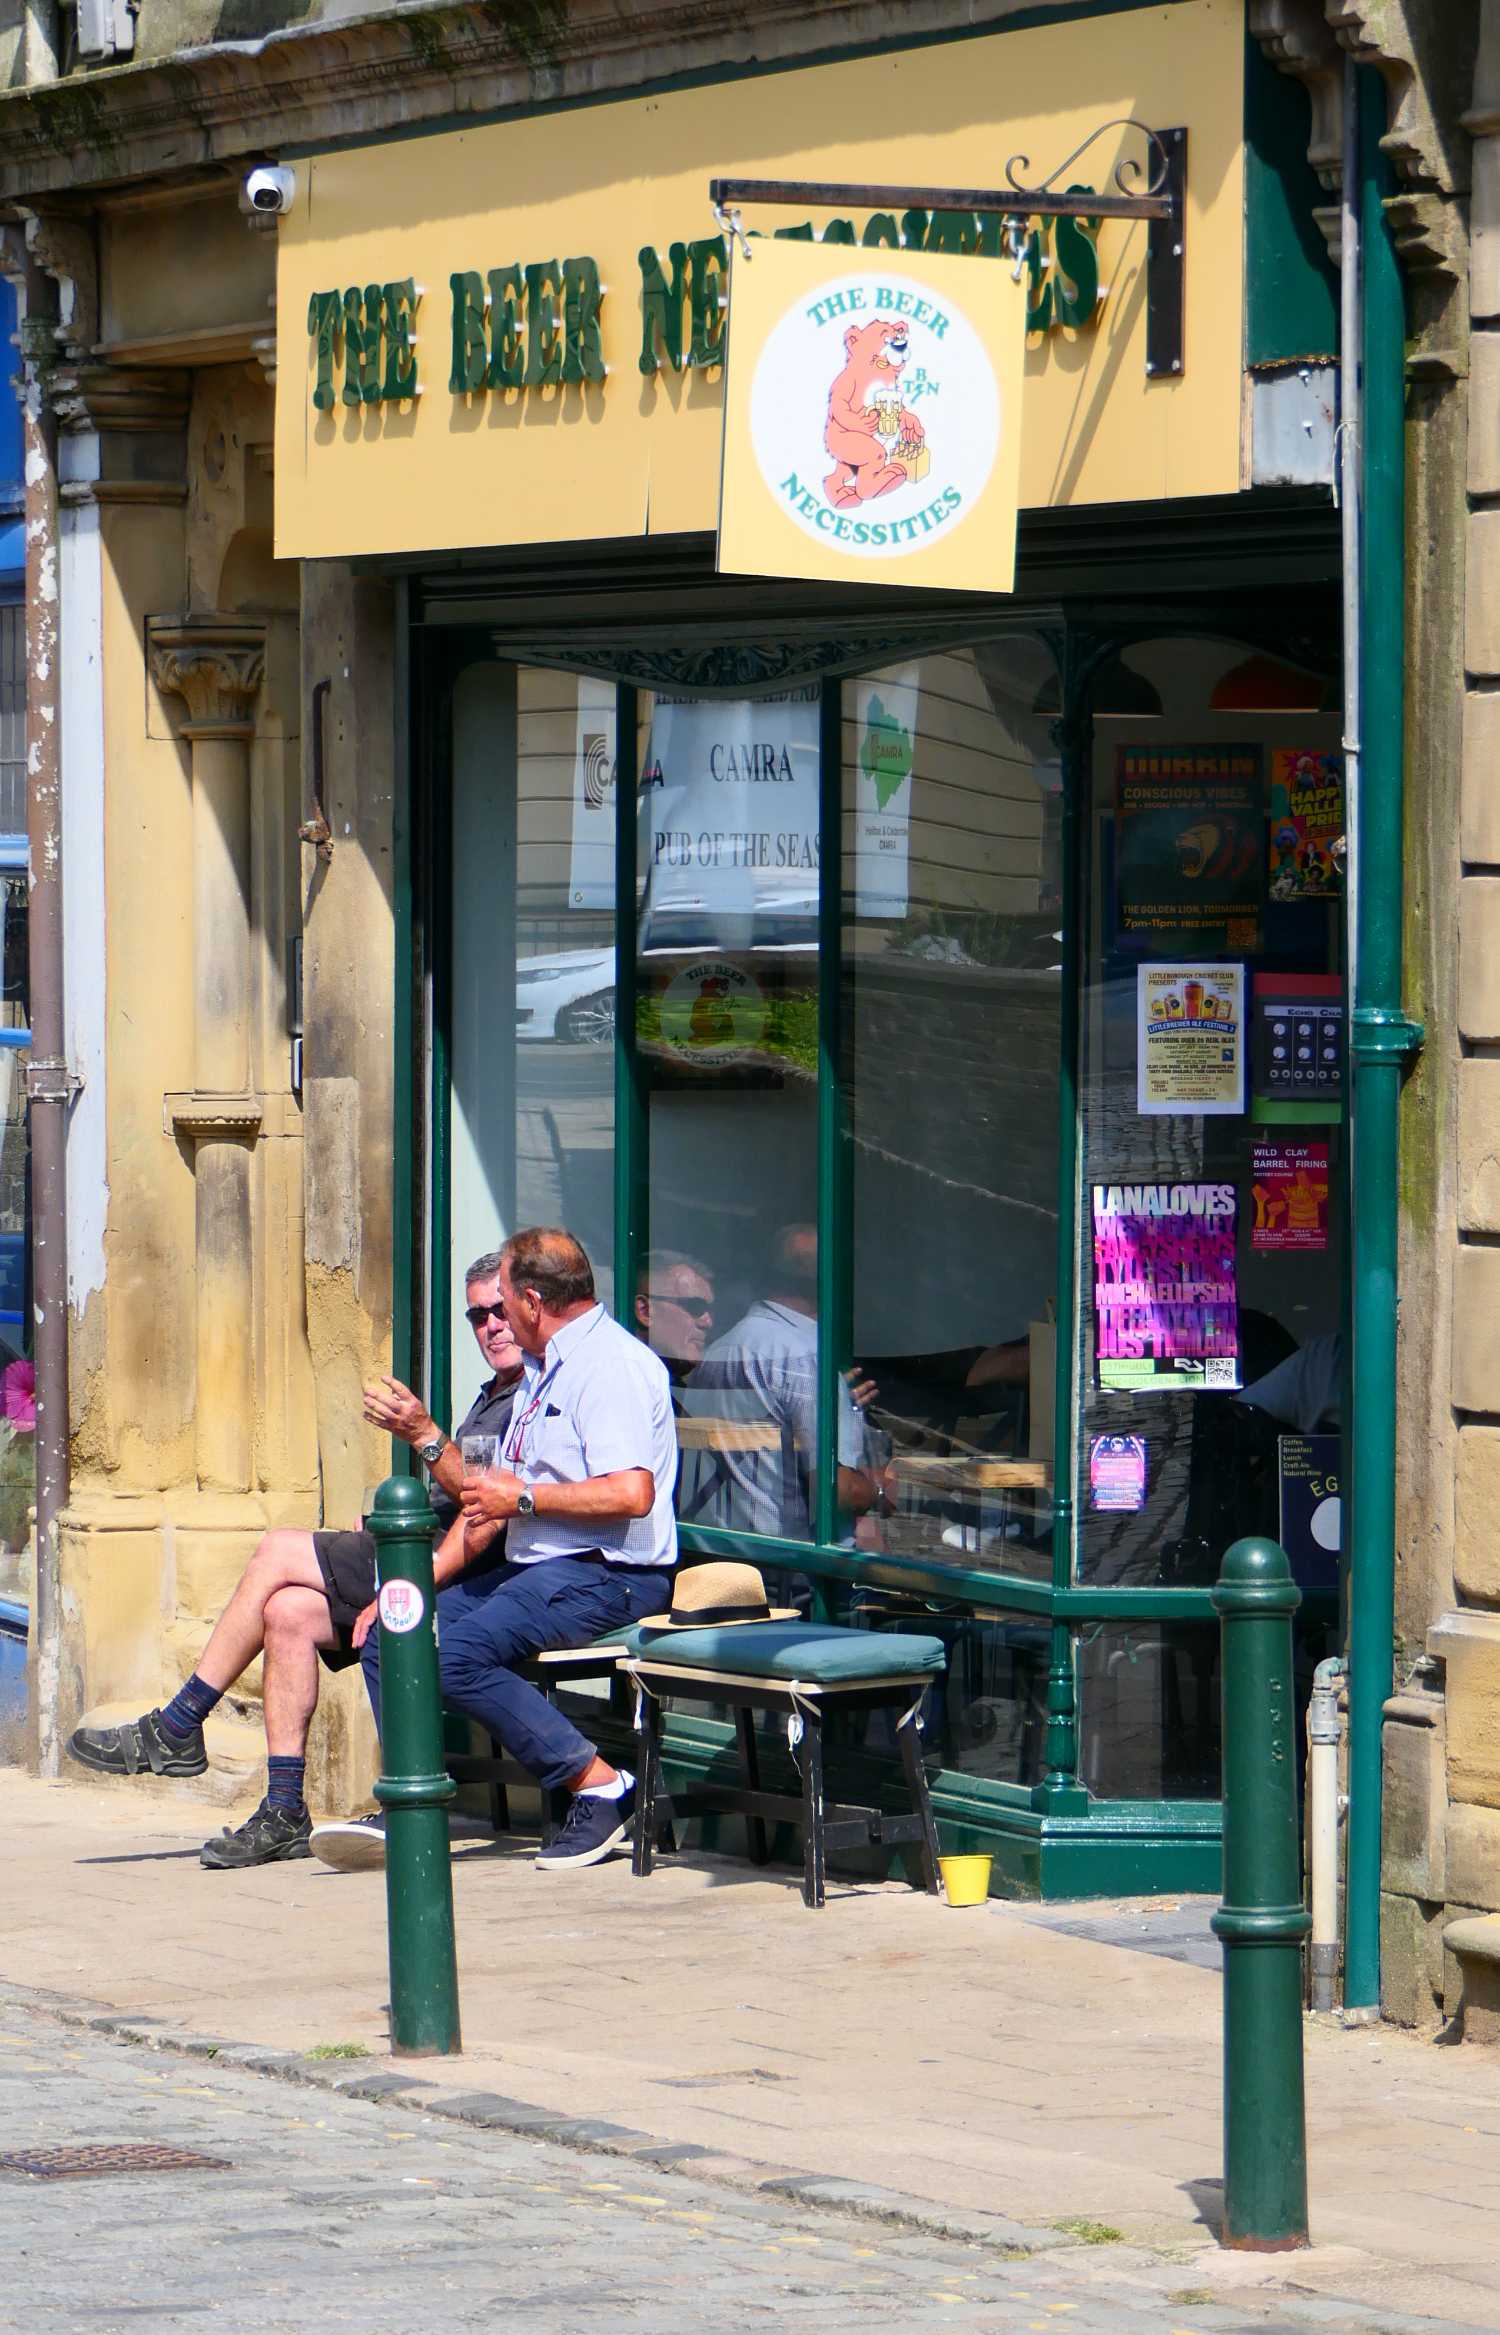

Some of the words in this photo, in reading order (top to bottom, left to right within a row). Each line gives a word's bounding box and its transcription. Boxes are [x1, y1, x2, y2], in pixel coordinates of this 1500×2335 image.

[806, 287, 868, 329] THE
[874, 287, 951, 341] BEER
[308, 277, 418, 411] THE
[448, 256, 606, 396] BEER
[780, 472, 963, 546] NECESSITIES
[710, 743, 795, 783] CAMRA
[1123, 786, 1201, 799] CONSCIOUS
[654, 831, 692, 866] PUB
[698, 832, 724, 867] OF
[730, 832, 771, 867] THE
[1141, 904, 1177, 914] GOLDEN
[1253, 1160, 1289, 1168] BARREL
[1296, 1160, 1328, 1168] FIRING
[1254, 1149, 1277, 1157] WILD
[1285, 1149, 1308, 1157] CLAY
